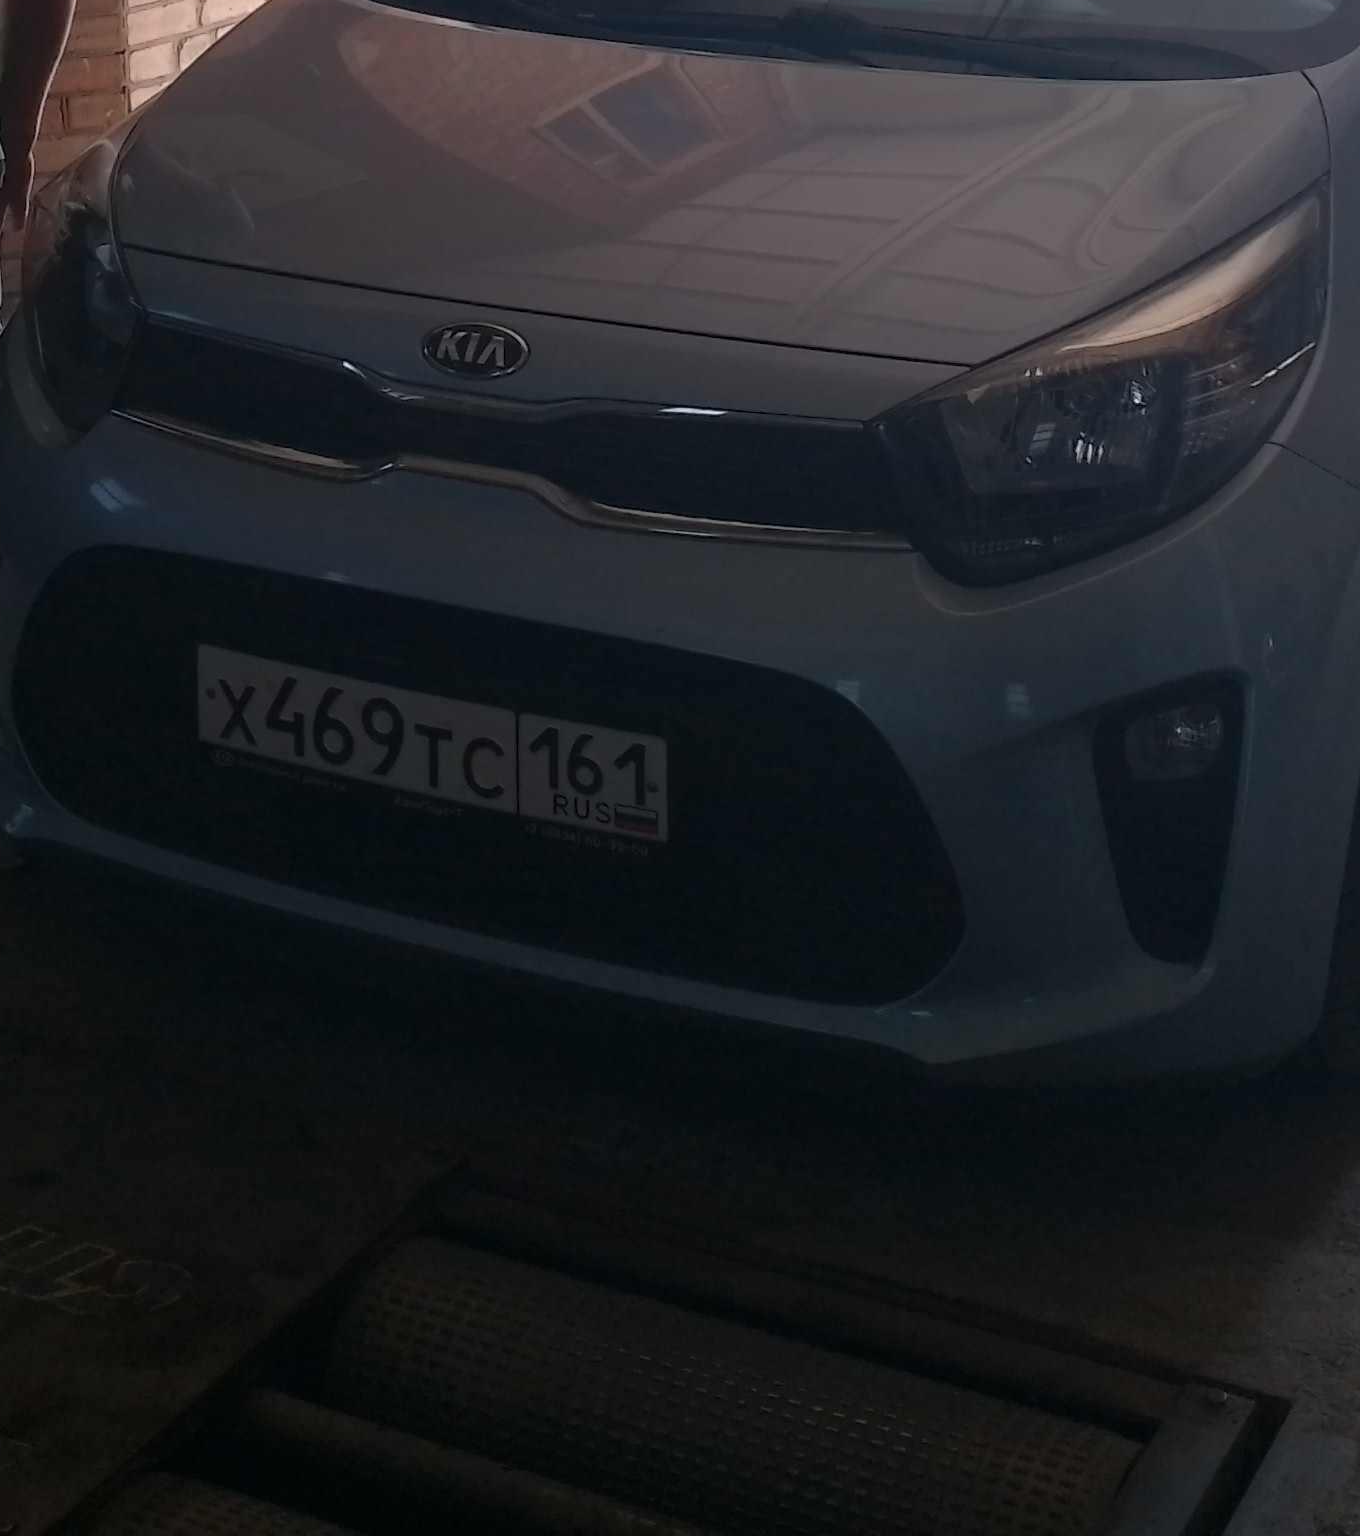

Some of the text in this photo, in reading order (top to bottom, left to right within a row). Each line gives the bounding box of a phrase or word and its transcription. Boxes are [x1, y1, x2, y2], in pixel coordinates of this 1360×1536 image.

[436, 329, 505, 368] KIA
[529, 726, 647, 806] 161
[552, 792, 611, 825] RUS
